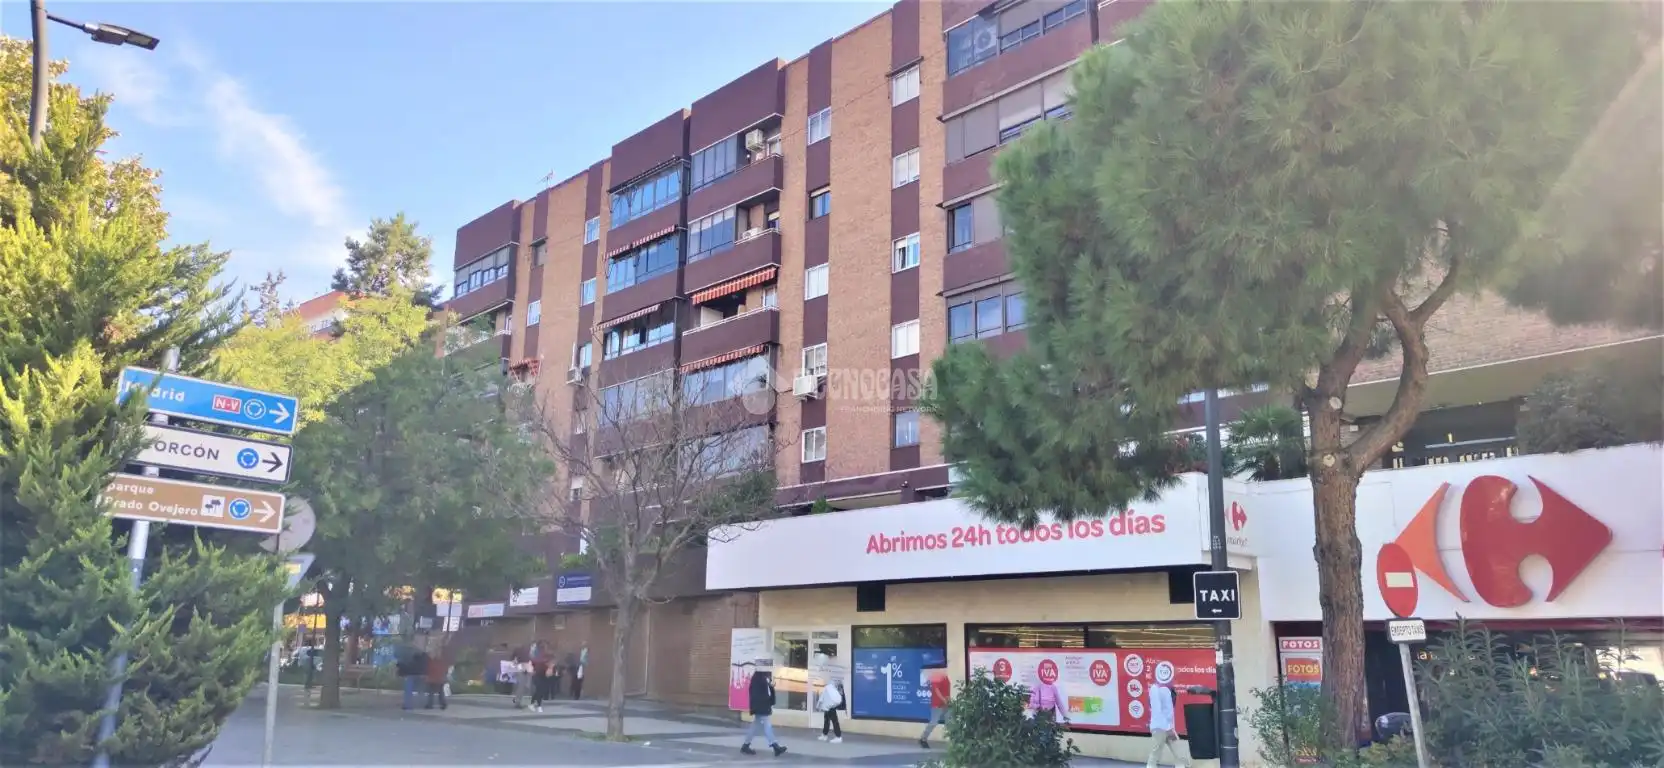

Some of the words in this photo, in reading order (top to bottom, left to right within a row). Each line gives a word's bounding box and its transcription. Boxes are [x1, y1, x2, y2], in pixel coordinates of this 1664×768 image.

[124, 380, 185, 402] Mdrid
[215, 398, 240, 411] N-V
[148, 501, 199, 517] Ovejero
[866, 530, 947, 554] Abrimos
[951, 524, 991, 548] 24h
[996, 521, 1063, 545] todos
[1068, 518, 1104, 540] los
[1109, 508, 1166, 537] días
[1199, 589, 1236, 602] TAXI
[1282, 640, 1318, 649] FOTOS
[1041, 669, 1056, 678] IVA
[1287, 664, 1320, 674] FOTOS
